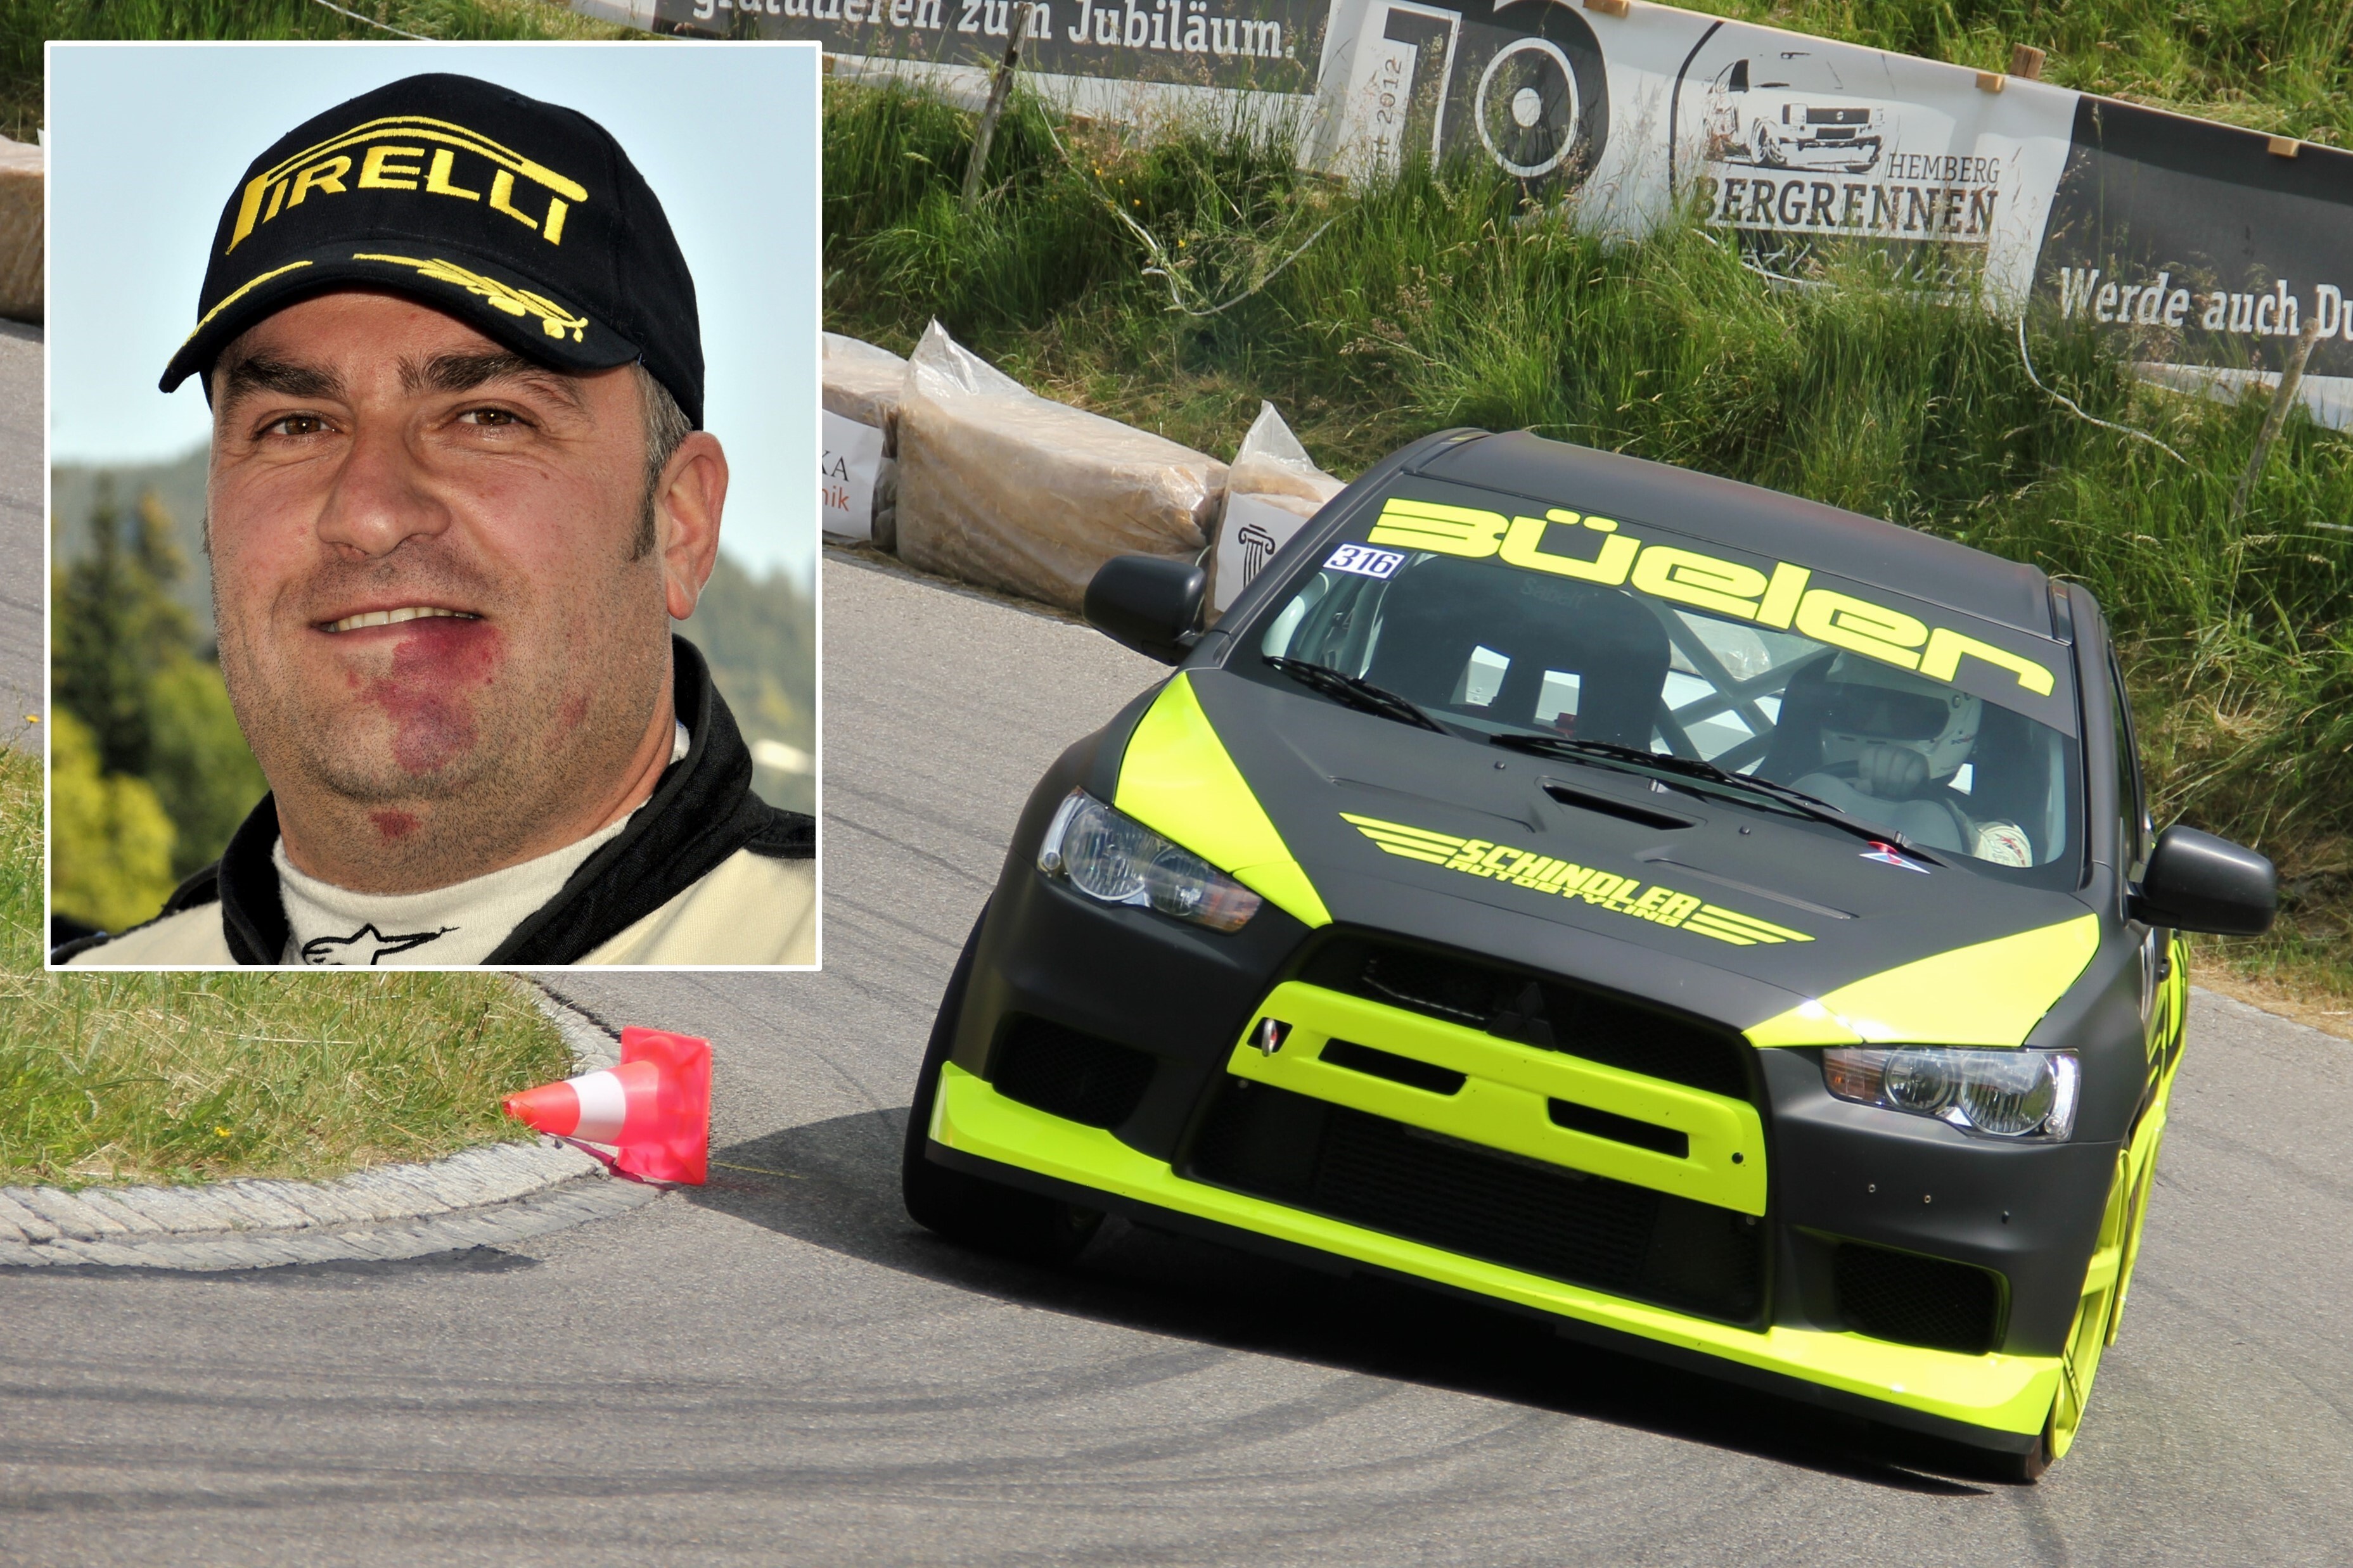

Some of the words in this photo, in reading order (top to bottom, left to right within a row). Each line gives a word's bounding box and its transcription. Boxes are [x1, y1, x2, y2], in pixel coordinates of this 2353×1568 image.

[693, 0, 941, 30] guieren
[957, 0, 1052, 39] zum
[1376, 58, 1402, 124] 2012
[226, 115, 588, 255] PIRELLI
[1887, 152, 2001, 183] HEMBERG
[1696, 176, 1999, 237] BERGRENNEN
[2060, 266, 2190, 326] Werde
[2202, 279, 2300, 336] auch
[1330, 547, 1398, 574] 316
[1367, 497, 2055, 697] Büeler
[1445, 858, 1683, 928] AUTOSTYLING
[1453, 839, 1702, 920] SCHINDLER
